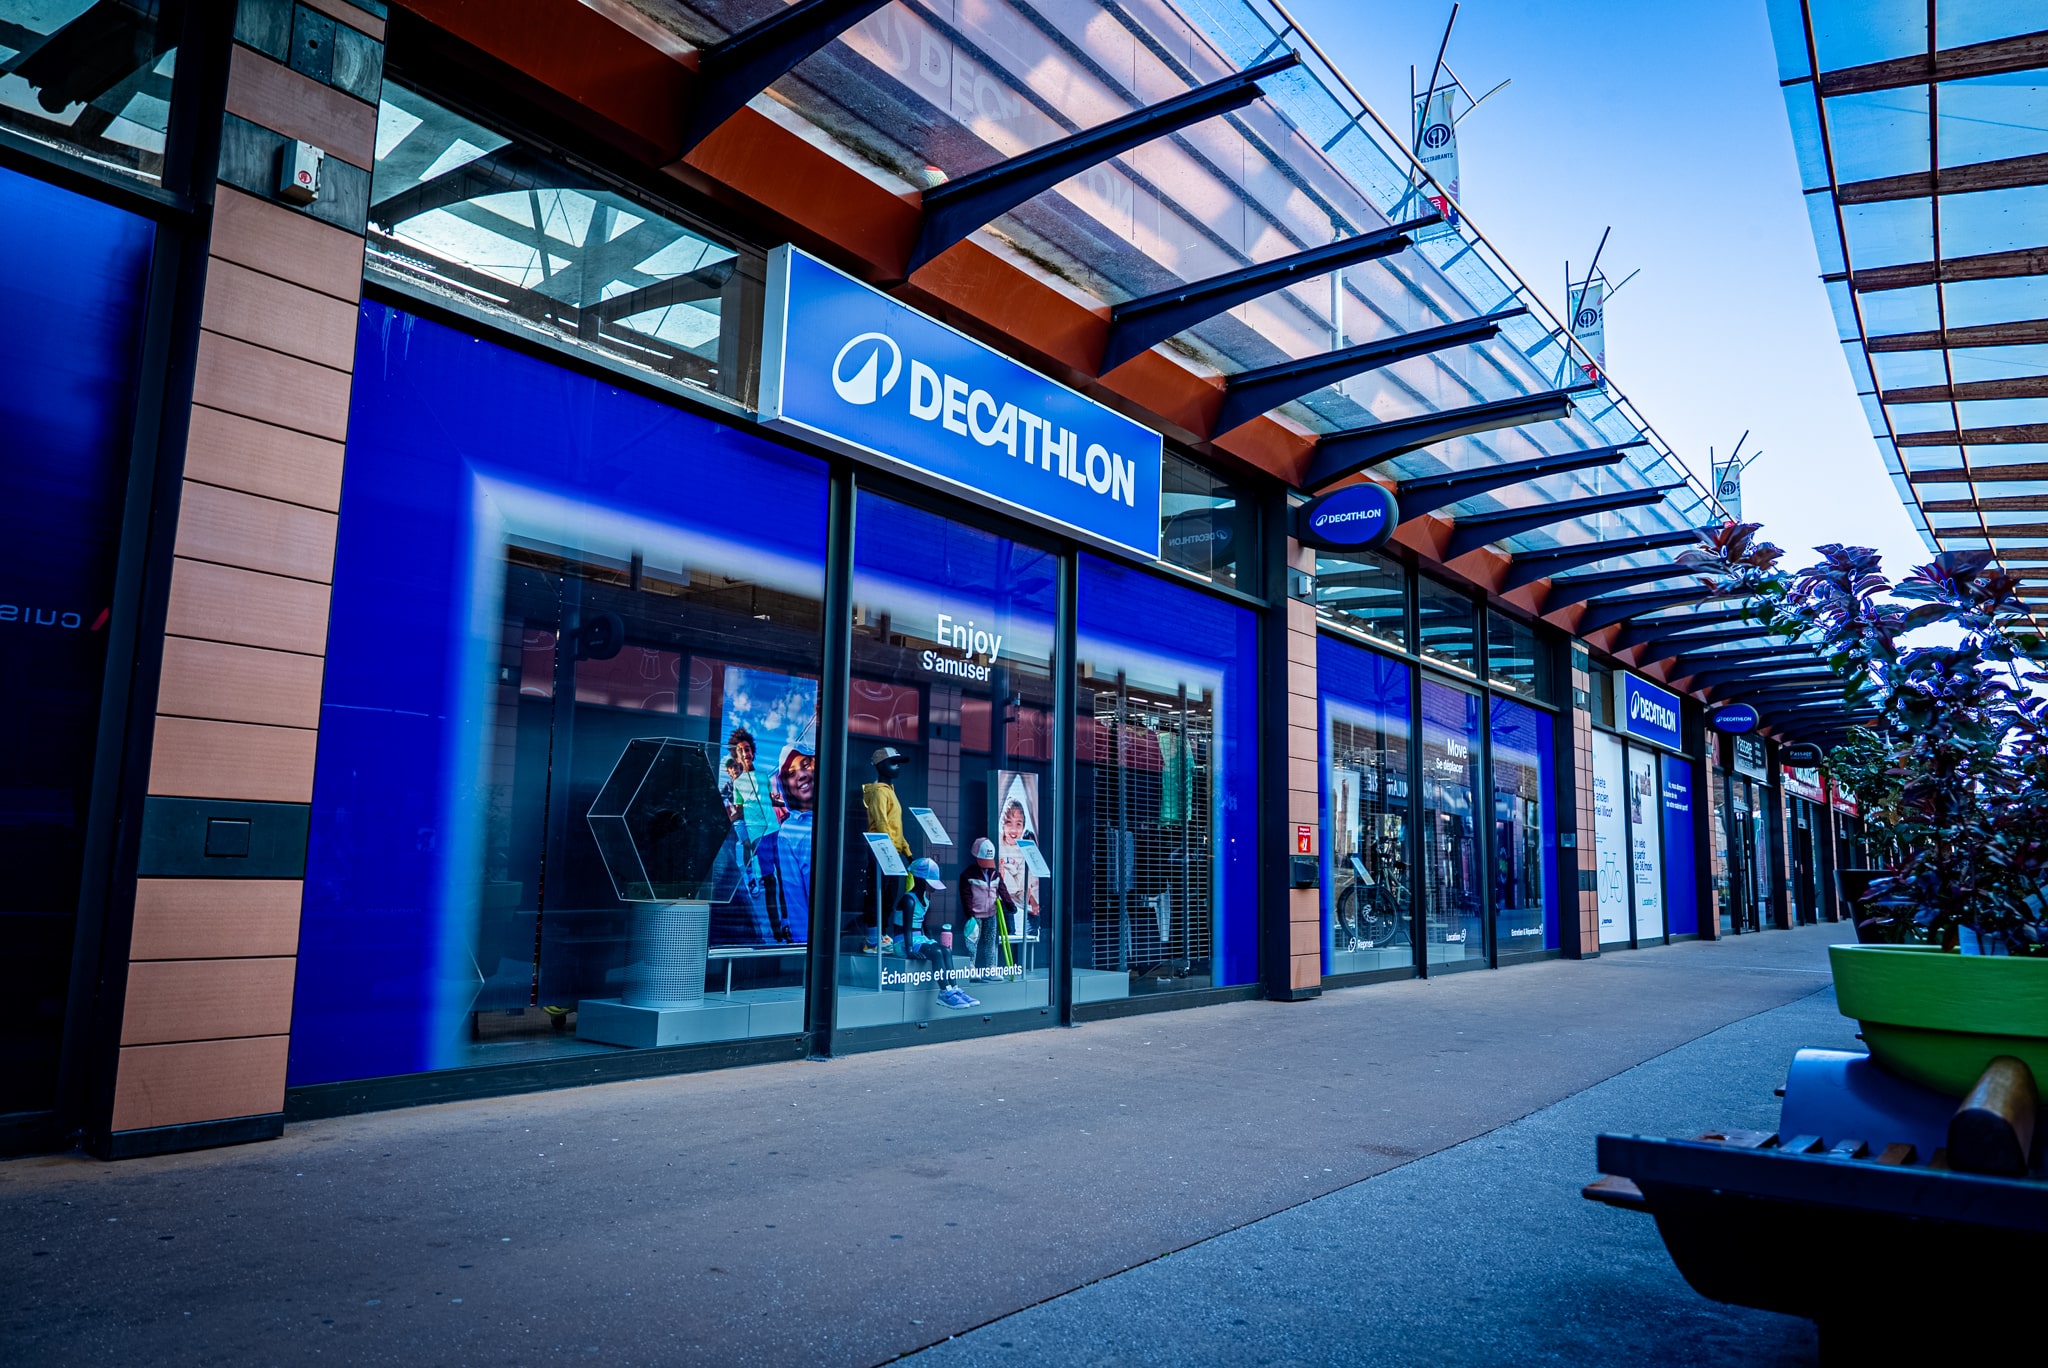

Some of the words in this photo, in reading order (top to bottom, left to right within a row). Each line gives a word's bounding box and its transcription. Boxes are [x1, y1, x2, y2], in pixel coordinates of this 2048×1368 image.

[909, 358, 1136, 508] DECATHLON
[1328, 508, 1382, 524] DECATHLON
[937, 613, 1002, 664] Enjoy
[922, 650, 991, 682] S'amuser
[1640, 697, 1676, 732] DECATHLON
[1447, 738, 1468, 759] Move
[1436, 757, 1443, 769] Se
[1443, 759, 1464, 774] déplacer
[1357, 939, 1374, 949] Reprise
[1446, 932, 1461, 942] Location
[881, 966, 932, 986] Échanges
[934, 968, 943, 981] et
[945, 963, 1023, 980] remboursements
